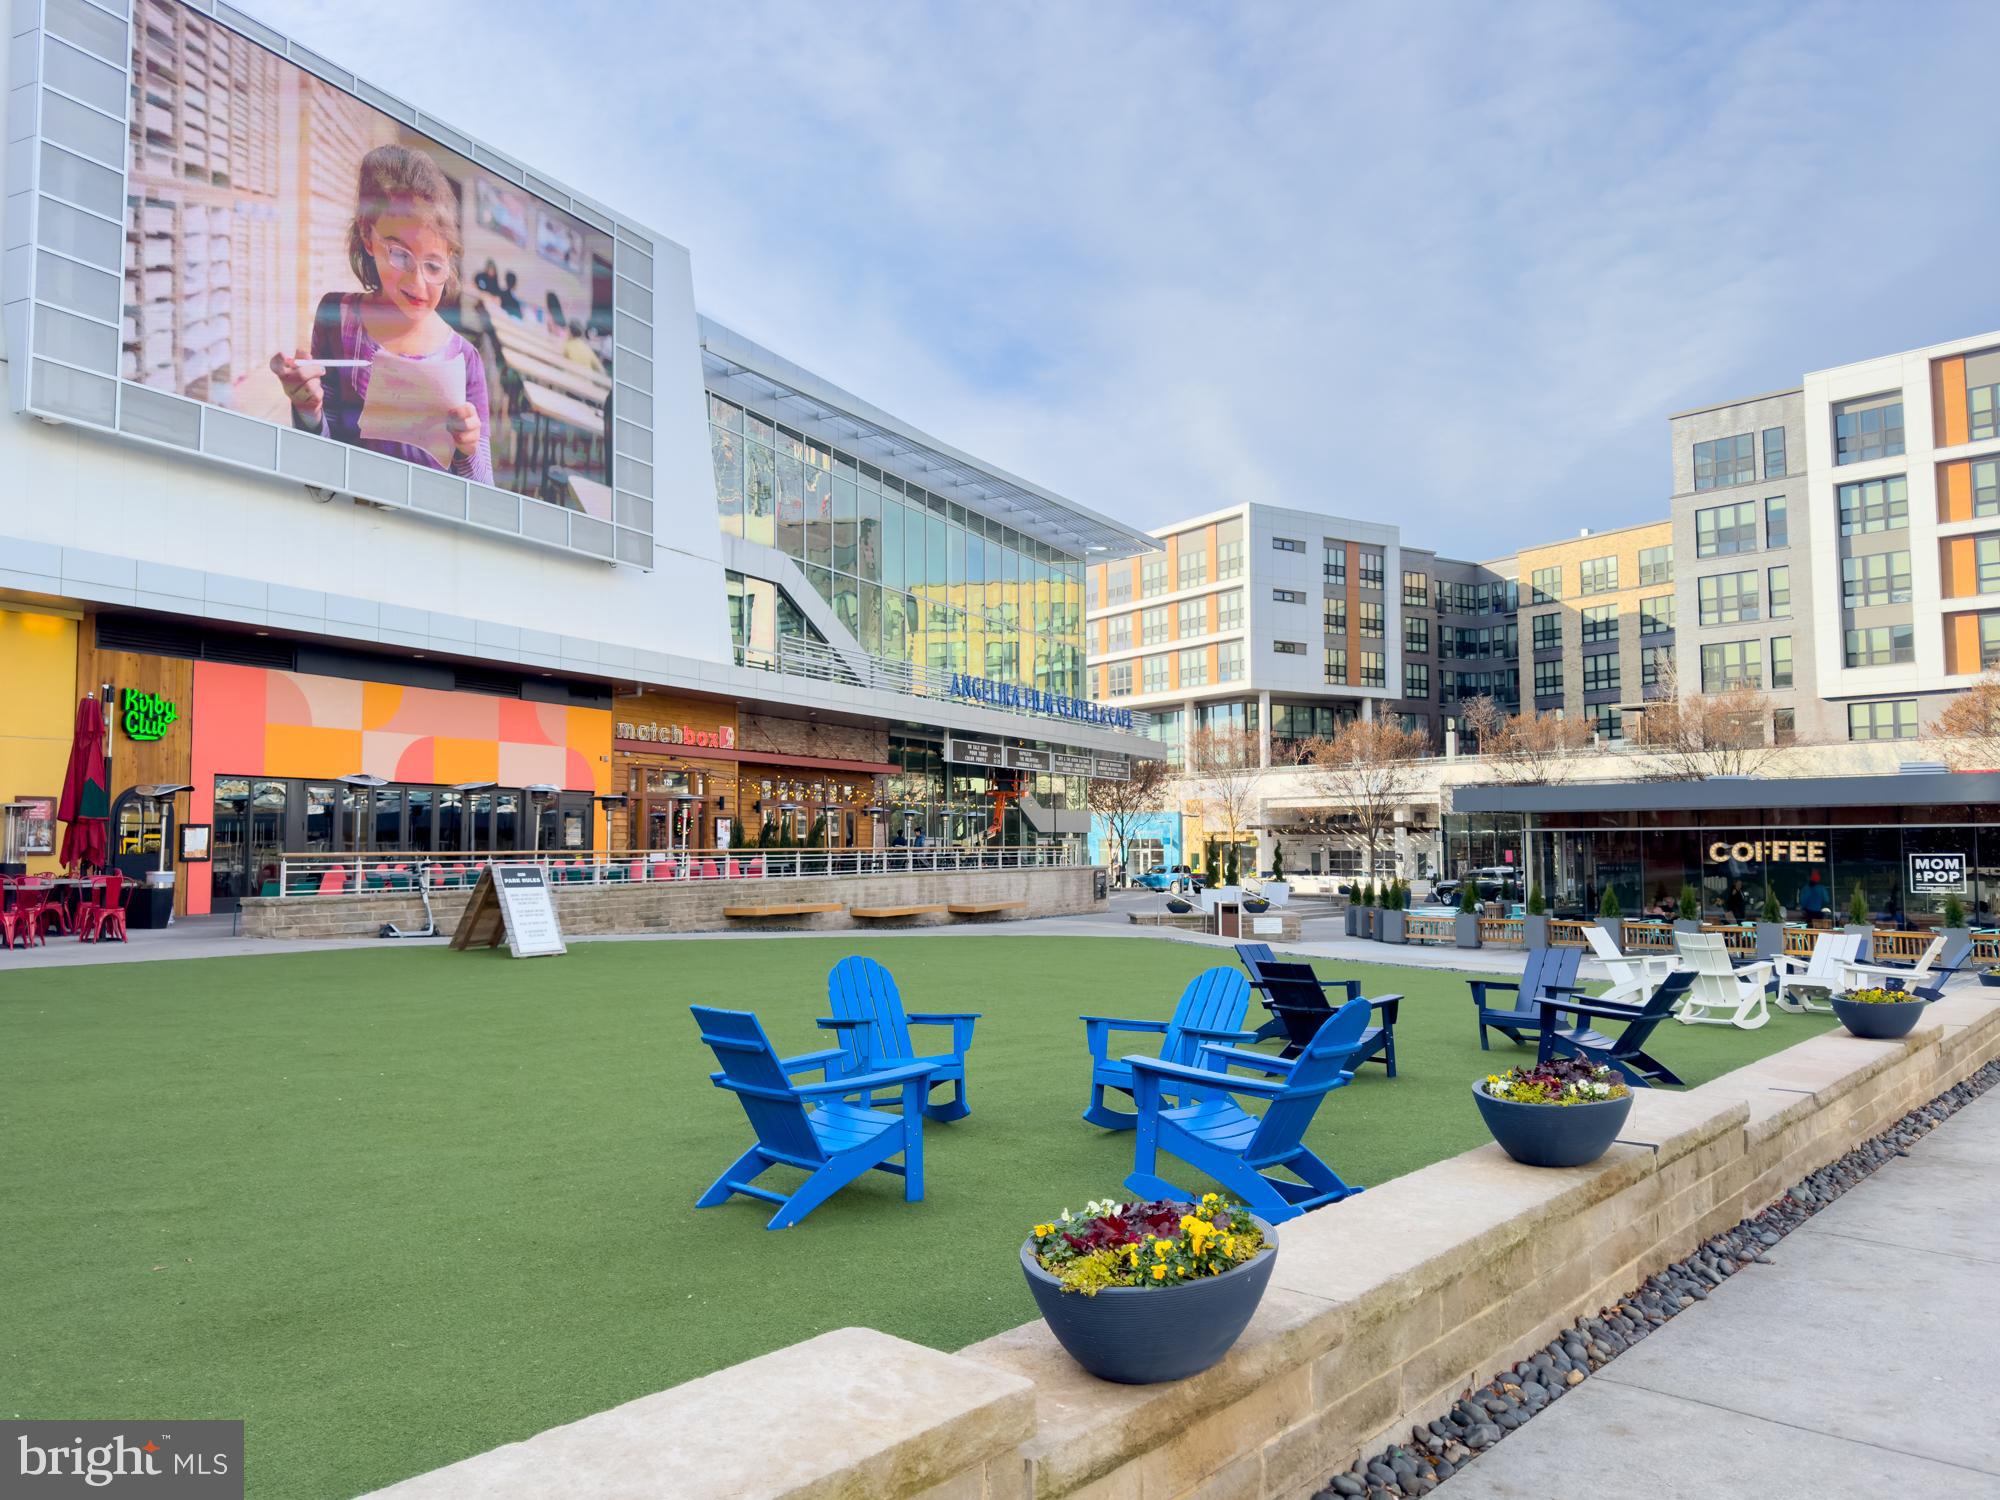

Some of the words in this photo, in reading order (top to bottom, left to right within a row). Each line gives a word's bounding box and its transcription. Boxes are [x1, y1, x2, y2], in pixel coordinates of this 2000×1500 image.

[125, 687, 179, 723] Kirby
[950, 673, 1020, 708] ANGELIKA
[1024, 687, 1053, 714] FILM
[1057, 696, 1098, 724] CENTER
[1108, 707, 1133, 729] CAFE
[126, 710, 167, 737] Club
[616, 721, 719, 748] matchbox
[1709, 841, 1826, 862] COFFEE
[1915, 858, 1960, 870] MOM
[1923, 871, 1961, 883] POP
